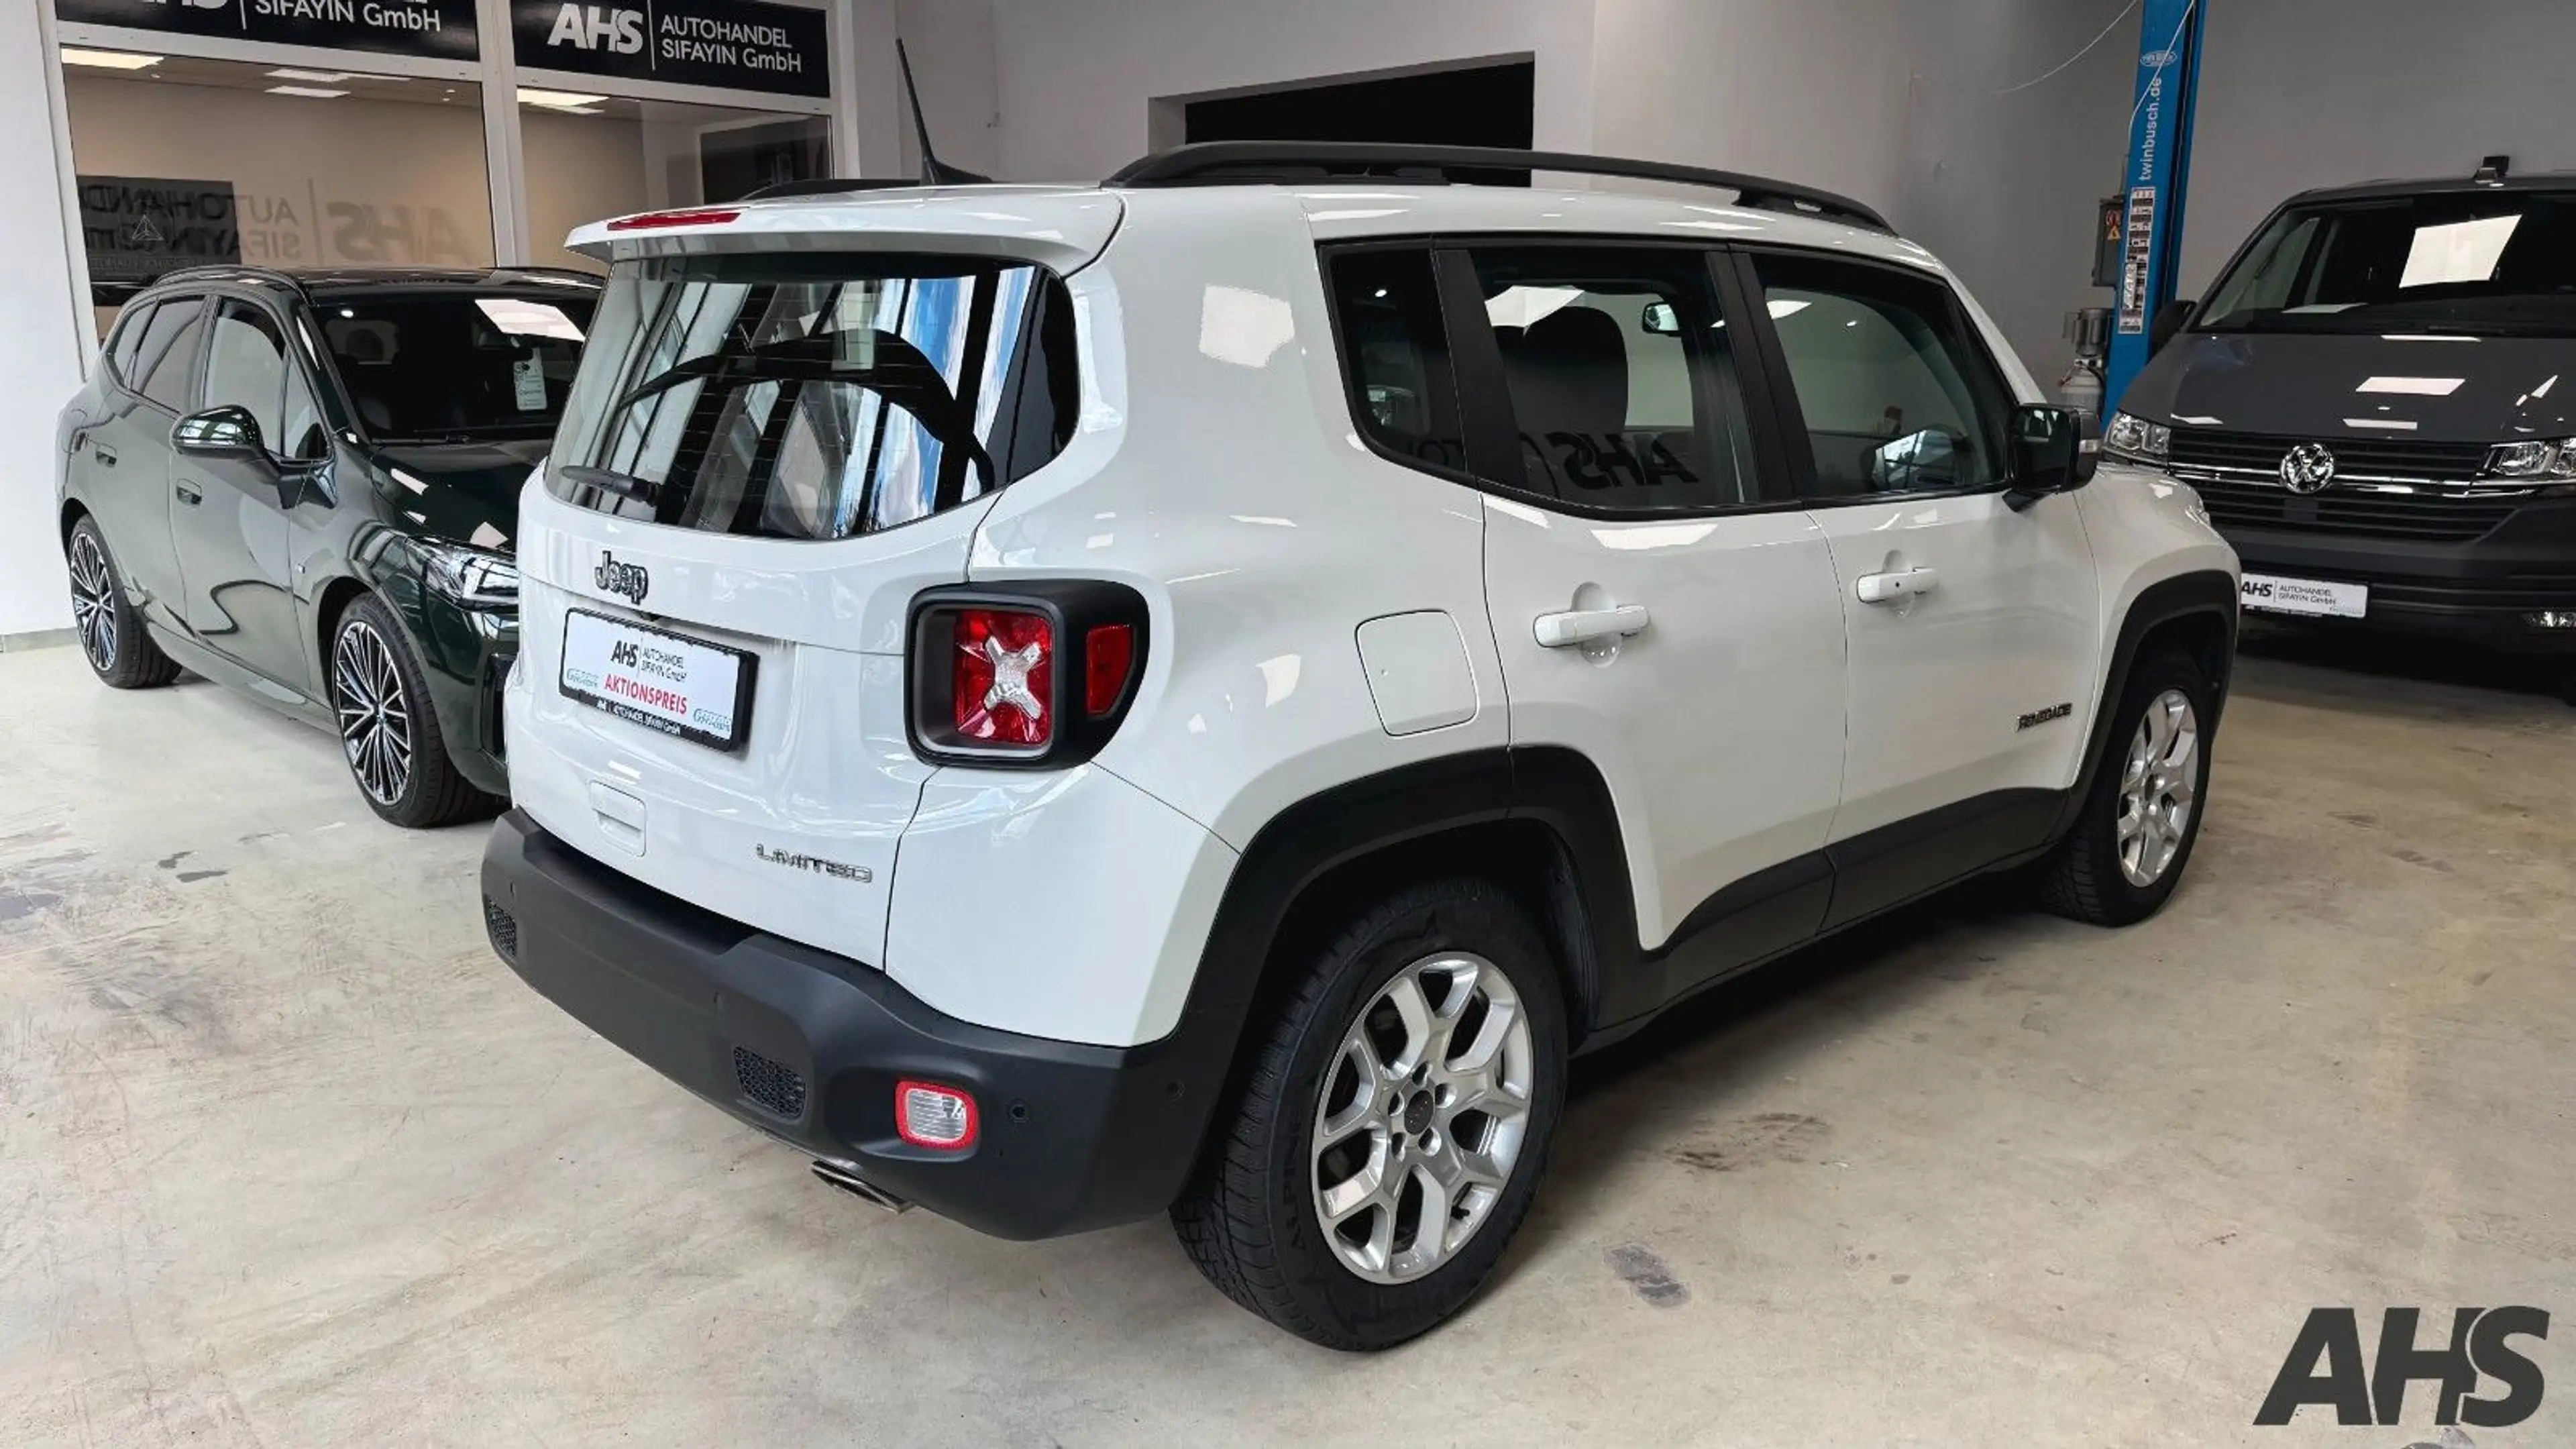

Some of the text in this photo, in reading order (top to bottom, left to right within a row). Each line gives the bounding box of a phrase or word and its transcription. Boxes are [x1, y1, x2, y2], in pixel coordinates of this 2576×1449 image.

[256, 0, 441, 32] SIFAYIN GmbH
[547, 2, 644, 54] AHS
[661, 14, 792, 49] AUTOHANDEL
[661, 41, 802, 72] SIFAYIN GmbH
[2138, 77, 2162, 181] twinbusch.de
[594, 549, 649, 606] Jeep
[2241, 581, 2273, 597] AHS
[610, 639, 639, 668] AHS
[604, 673, 688, 715] AKTIONSPREIS
[756, 843, 873, 883] LIMITED
